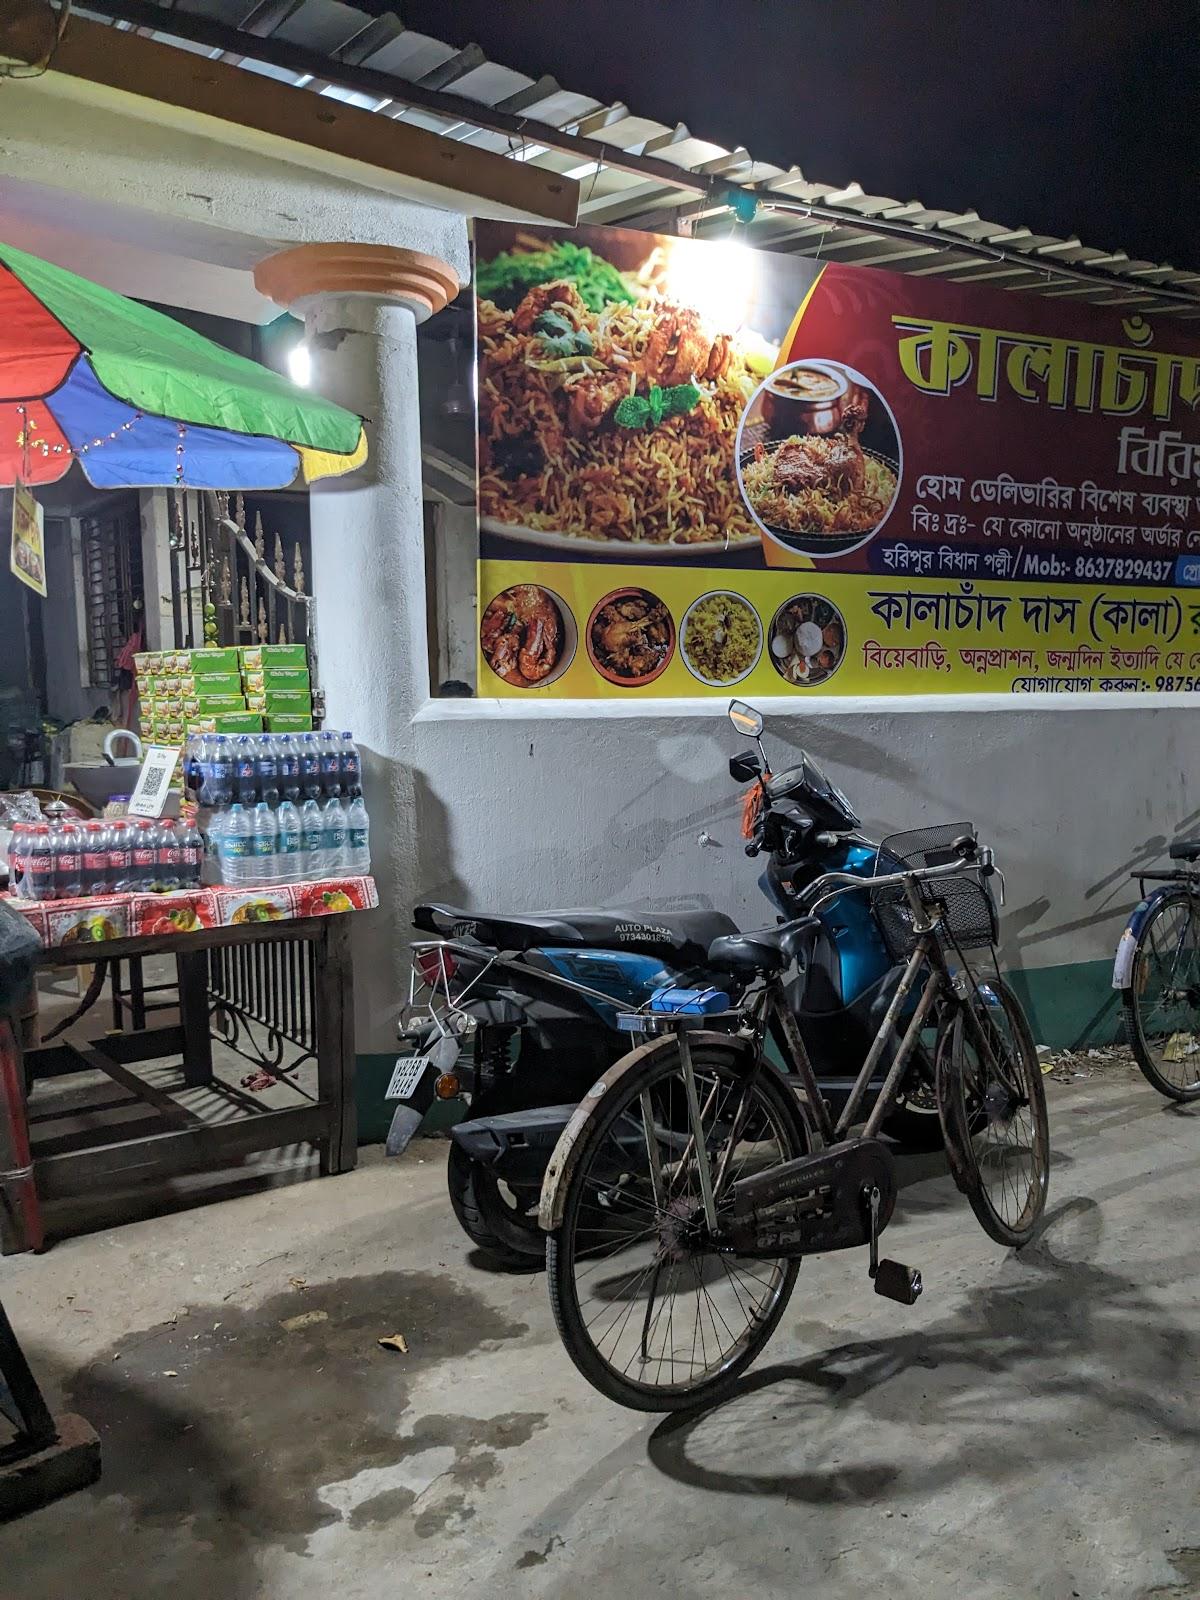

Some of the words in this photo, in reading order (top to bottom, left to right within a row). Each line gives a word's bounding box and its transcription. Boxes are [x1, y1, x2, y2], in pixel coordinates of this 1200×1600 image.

[1117, 426, 1200, 486] বিরি
[916, 474, 966, 503] হোম
[970, 473, 1076, 510] ডেলিভারির
[1079, 480, 1138, 514] বিশেষ
[1140, 492, 1192, 522] ব্যবস্থা
[983, 516, 1006, 537] যে
[1009, 518, 1063, 541] কোনো
[1065, 516, 1138, 549] অনুষ্ঠানের
[1141, 523, 1184, 548] অর্ডার
[881, 543, 935, 574] হরিপুর
[937, 545, 981, 572] বিধান
[1075, 556, 1173, 581] 8637829437
[867, 582, 1012, 633] কালাচাঁদ
[1019, 596, 1082, 634] দাস
[1089, 593, 1182, 643] (কালা)
[959, 648, 1039, 674] অন্নপ্রাশন,
[1046, 644, 1105, 672] জন্মদিন
[1109, 645, 1161, 671] ইত্যাদি
[1165, 652, 1185, 671] যে
[614, 923, 642, 933] AUTO
[643, 924, 673, 936] PLAZA
